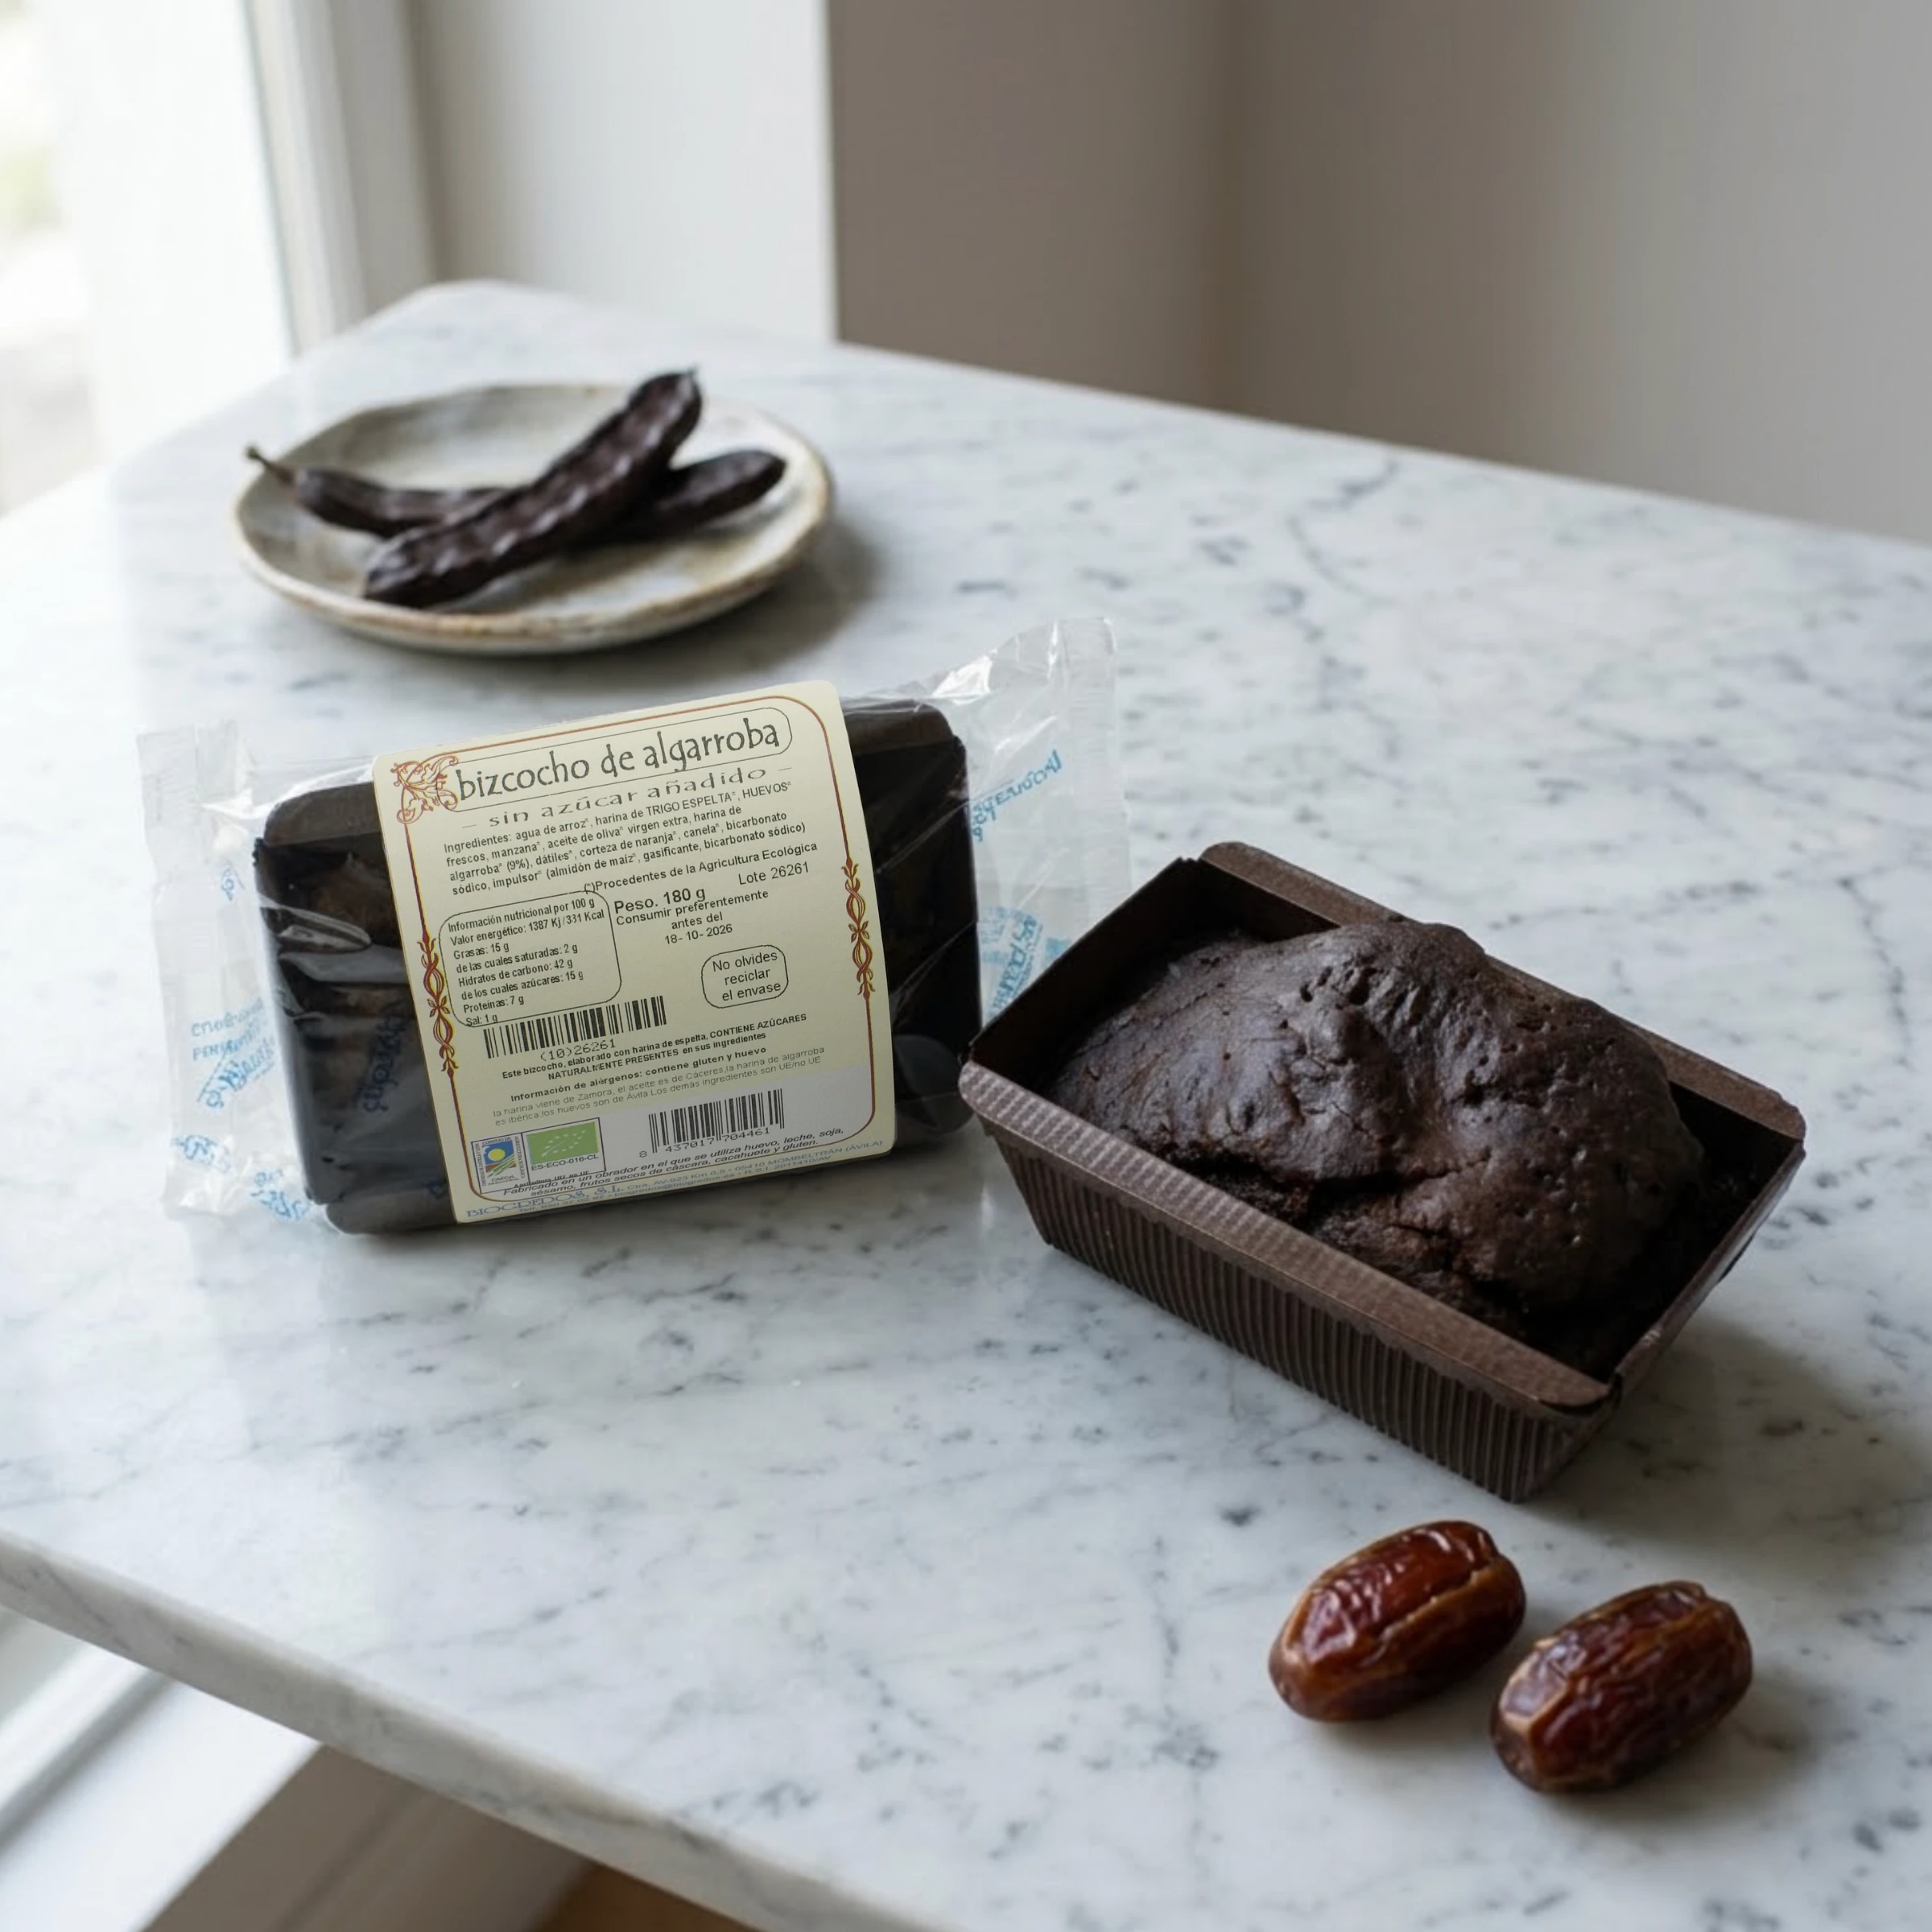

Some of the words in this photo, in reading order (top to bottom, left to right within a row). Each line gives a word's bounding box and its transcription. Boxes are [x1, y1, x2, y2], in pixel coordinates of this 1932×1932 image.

[456, 750, 590, 801] bizcocho
[600, 744, 635, 778] de
[643, 718, 780, 773] algarroba
[489, 809, 529, 828] sin
[647, 767, 766, 799] añadido
[444, 834, 511, 853] Ingredientes:
[516, 829, 541, 840] agua
[543, 825, 556, 835] de
[595, 813, 628, 825] harina
[631, 809, 643, 819] de
[646, 802, 680, 816] TRIGO
[446, 853, 489, 867] frescos,
[547, 836, 578, 848] aceite
[580, 832, 593, 843] de
[627, 821, 660, 834] virgen
[663, 816, 691, 828] extra,
[693, 809, 726, 822] harina
[729, 806, 741, 815] de
[506, 858, 533, 873] (9%),
[580, 844, 617, 857] corteza
[620, 840, 633, 850] de
[725, 812, 786, 831] bicarbonato
[452, 882, 490, 895] sódico,
[546, 862, 591, 880] (almidón
[594, 859, 607, 869] de
[643, 843, 702, 862] gasificante,
[704, 831, 765, 849] bicarbonato
[768, 822, 805, 837] sódico)
[670, 867, 683, 877] de
[686, 865, 696, 874] la
[699, 854, 760, 873] Agricultura
[762, 843, 818, 860] Ecológica
[738, 872, 766, 885] Lote
[770, 861, 808, 879] 26261
[448, 915, 502, 932] Información
[504, 904, 552, 922] nutricional
[553, 903, 568, 915] por
[571, 898, 586, 910] 100
[588, 898, 595, 909] g
[614, 898, 658, 914] Peso.
[663, 888, 691, 904] 180
[696, 889, 705, 902] g
[616, 907, 671, 925] Consumir
[675, 890, 768, 917] preferentemente
[450, 935, 473, 946] Valor
[477, 926, 526, 941] energético:
[529, 919, 548, 931] 1387
[584, 909, 605, 922] Kcal
[671, 917, 702, 930] antes
[706, 911, 723, 923] del
[453, 947, 489, 960] Grasas:
[490, 942, 501, 953] 15
[503, 943, 510, 953] g
[456, 964, 468, 973] de
[469, 962, 482, 972] las
[485, 956, 513, 968] cuales
[514, 947, 562, 963] saturadas:
[564, 943, 569, 953] 2
[572, 944, 578, 954] g
[712, 960, 730, 972] No
[735, 952, 778, 968] olvides
[458, 974, 497, 987] Hidratos
[498, 970, 510, 980] de
[512, 963, 552, 977] carbono:
[554, 959, 564, 969] 42
[567, 960, 573, 968] g
[461, 991, 473, 1000] de
[474, 989, 488, 997] los
[490, 983, 518, 995] cuales
[521, 975, 564, 989] azúcares:
[565, 970, 576, 980] 15
[578, 972, 584, 980] g
[724, 969, 770, 985] reciclar
[510, 995, 514, 1005] 7
[518, 996, 524, 1005] g
[722, 989, 733, 1001] el
[737, 983, 781, 998] envase
[466, 1015, 482, 1026] Sal:
[502, 1070, 522, 1079] Este
[523, 1062, 566, 1075] bizcocho,
[568, 1052, 611, 1067] elaborado
[613, 1049, 630, 1057] con
[632, 1043, 660, 1054] harina
[662, 1040, 673, 1048] de
[675, 1034, 708, 1046] espelta,
[710, 1023, 755, 1038] CONTIENE
[757, 1013, 807, 1030] AZÚCARES
[625, 1048, 679, 1065] PRESENTES
[695, 1043, 711, 1052] sus
[713, 1033, 766, 1048] ingredientes
[510, 1085, 571, 1102] Información
[646, 1063, 689, 1075] contiene
[692, 1055, 724, 1068] gluten
[726, 1054, 732, 1062] y
[734, 1047, 766, 1059] huevo
[665, 1137, 715, 1153] 437017
[721, 1127, 770, 1142] 704461
[503, 1180, 558, 1195] Fabricado
[595, 1166, 638, 1179] obrador
[671, 1157, 691, 1165] que
[710, 1147, 741, 1158] utiliza
[744, 1141, 779, 1151] huevo,
[783, 1134, 815, 1144] leche,
[819, 1128, 844, 1137] soja,
[531, 1154, 599, 1171] ES-ECO-016-CL
